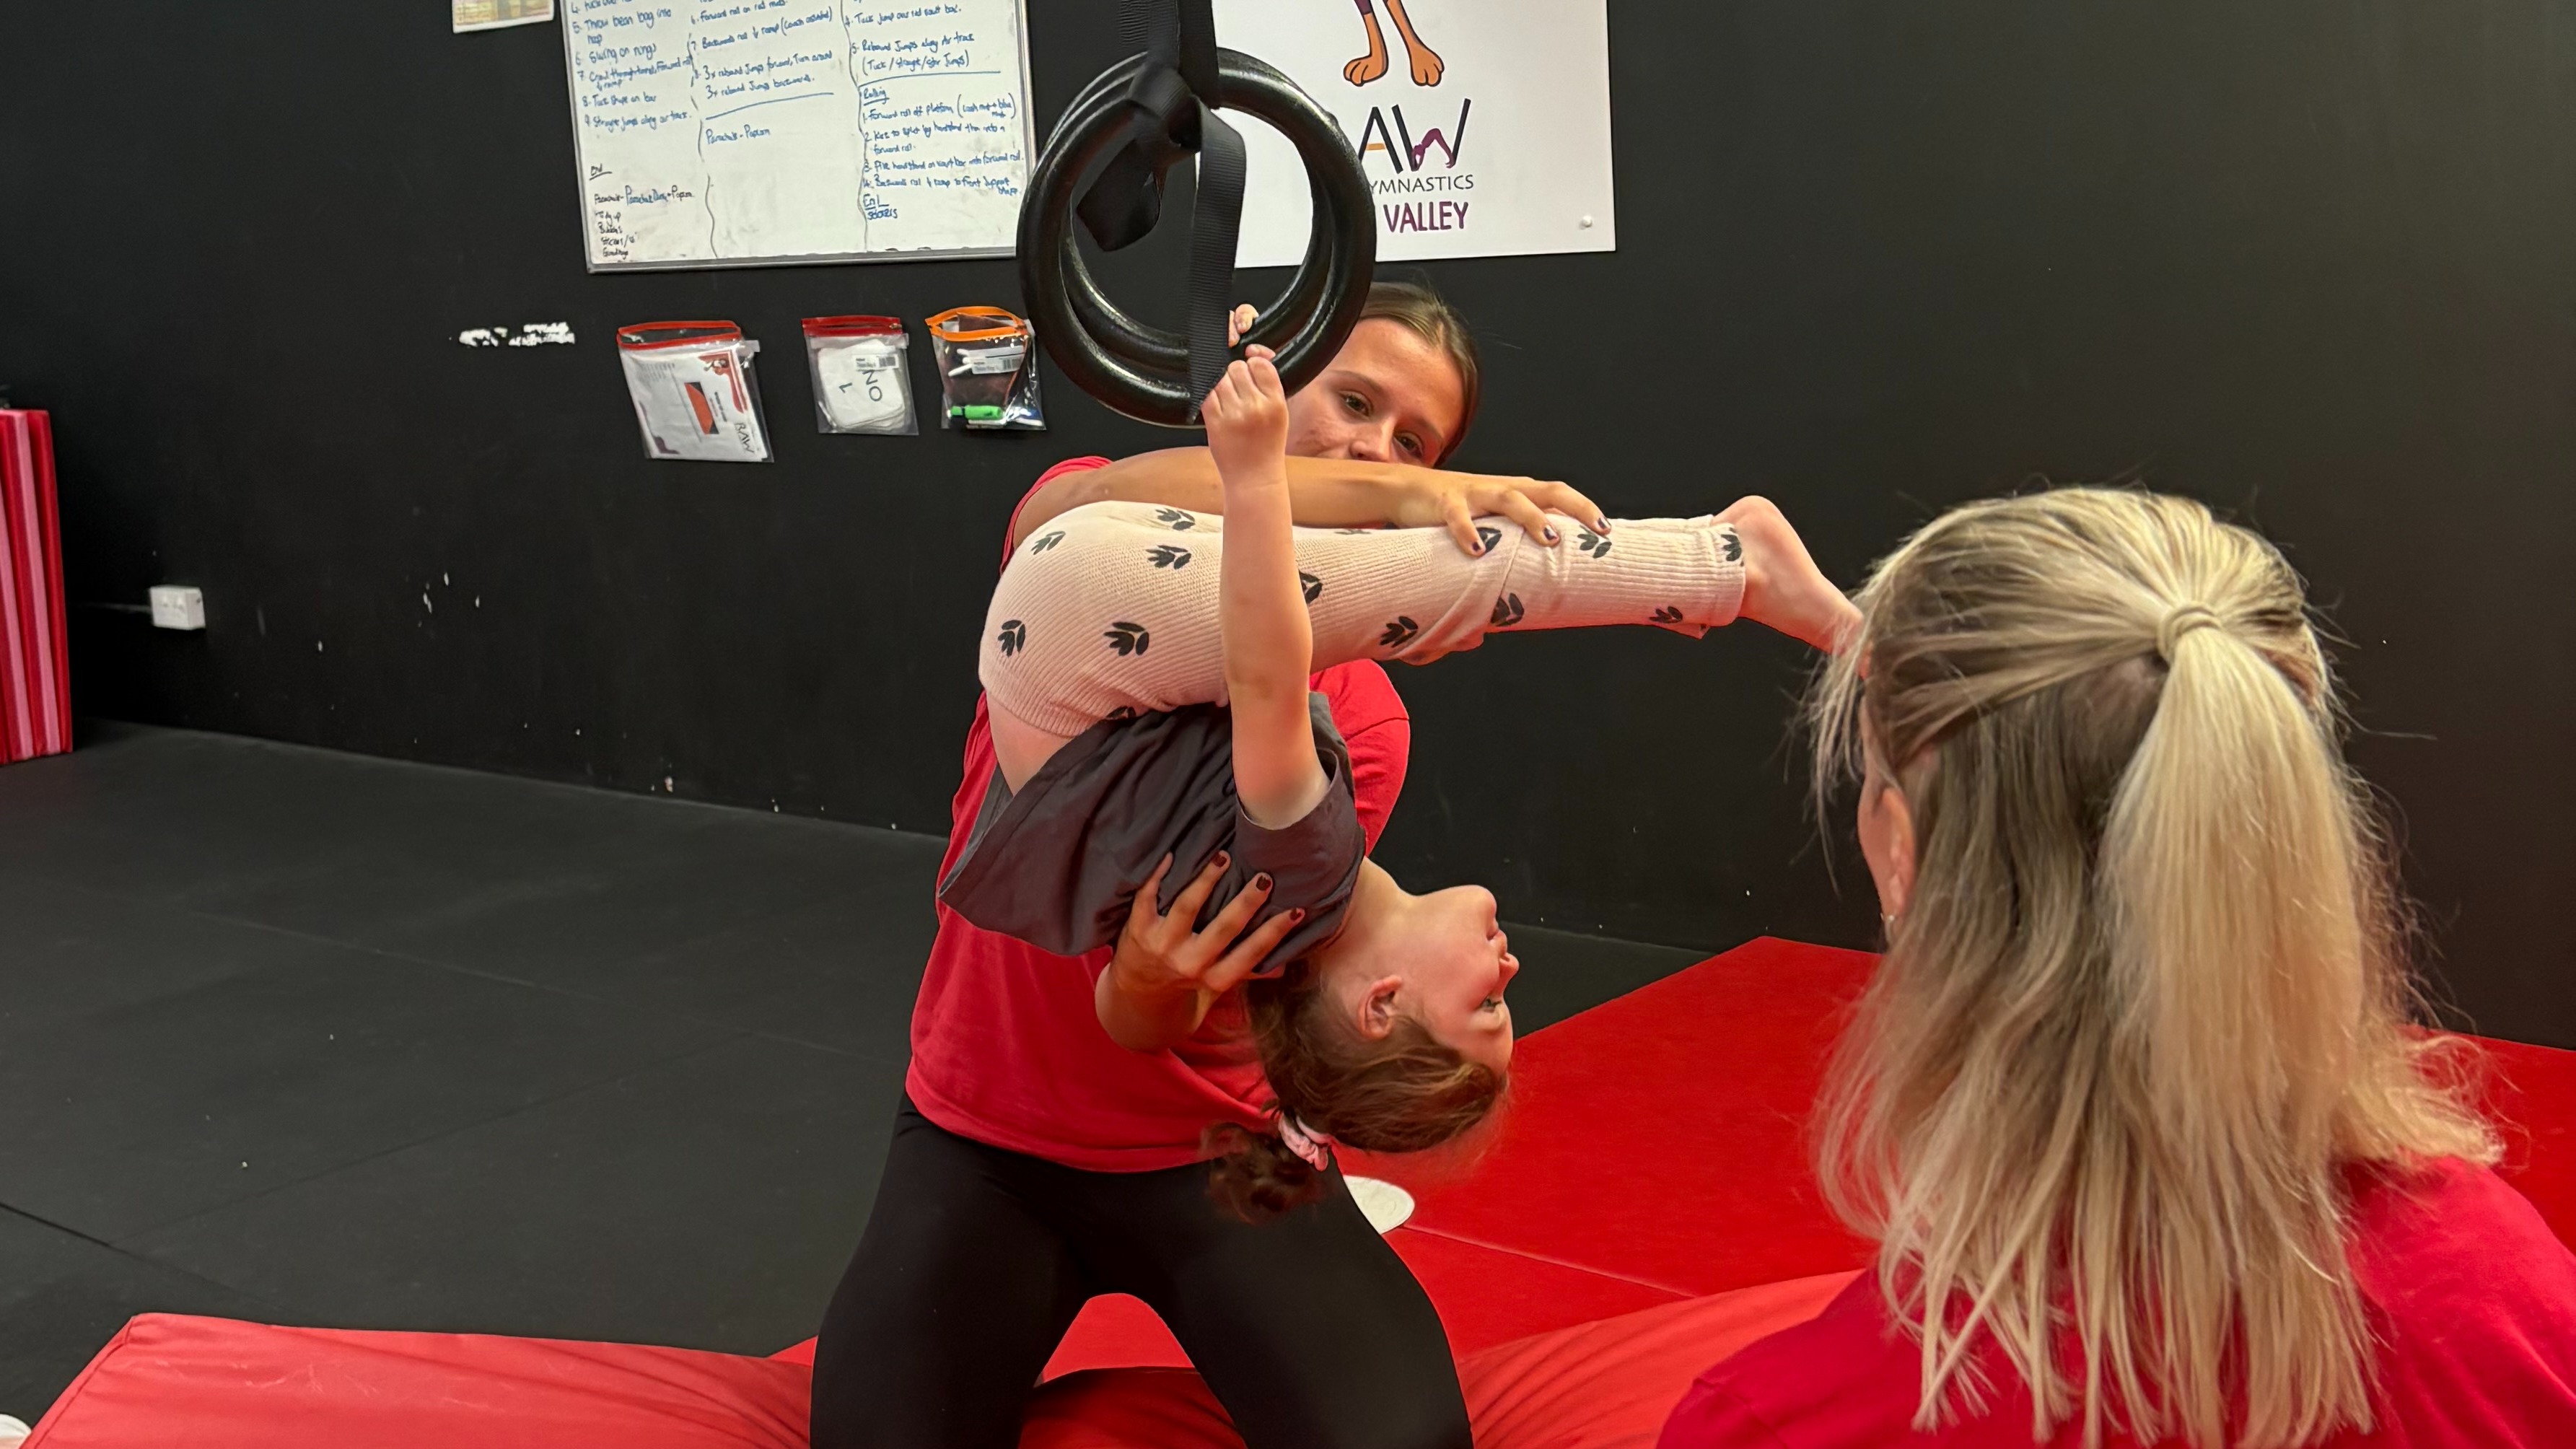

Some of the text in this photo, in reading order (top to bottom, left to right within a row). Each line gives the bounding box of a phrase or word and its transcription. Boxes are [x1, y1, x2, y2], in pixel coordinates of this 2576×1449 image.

[637, 11, 654, 29] bag
[619, 47, 629, 57] on
[1359, 98, 1471, 174] AW
[1370, 175, 1473, 195] YMNASTICS
[1383, 201, 1468, 233] VALLEY
[862, 369, 882, 402] ON
